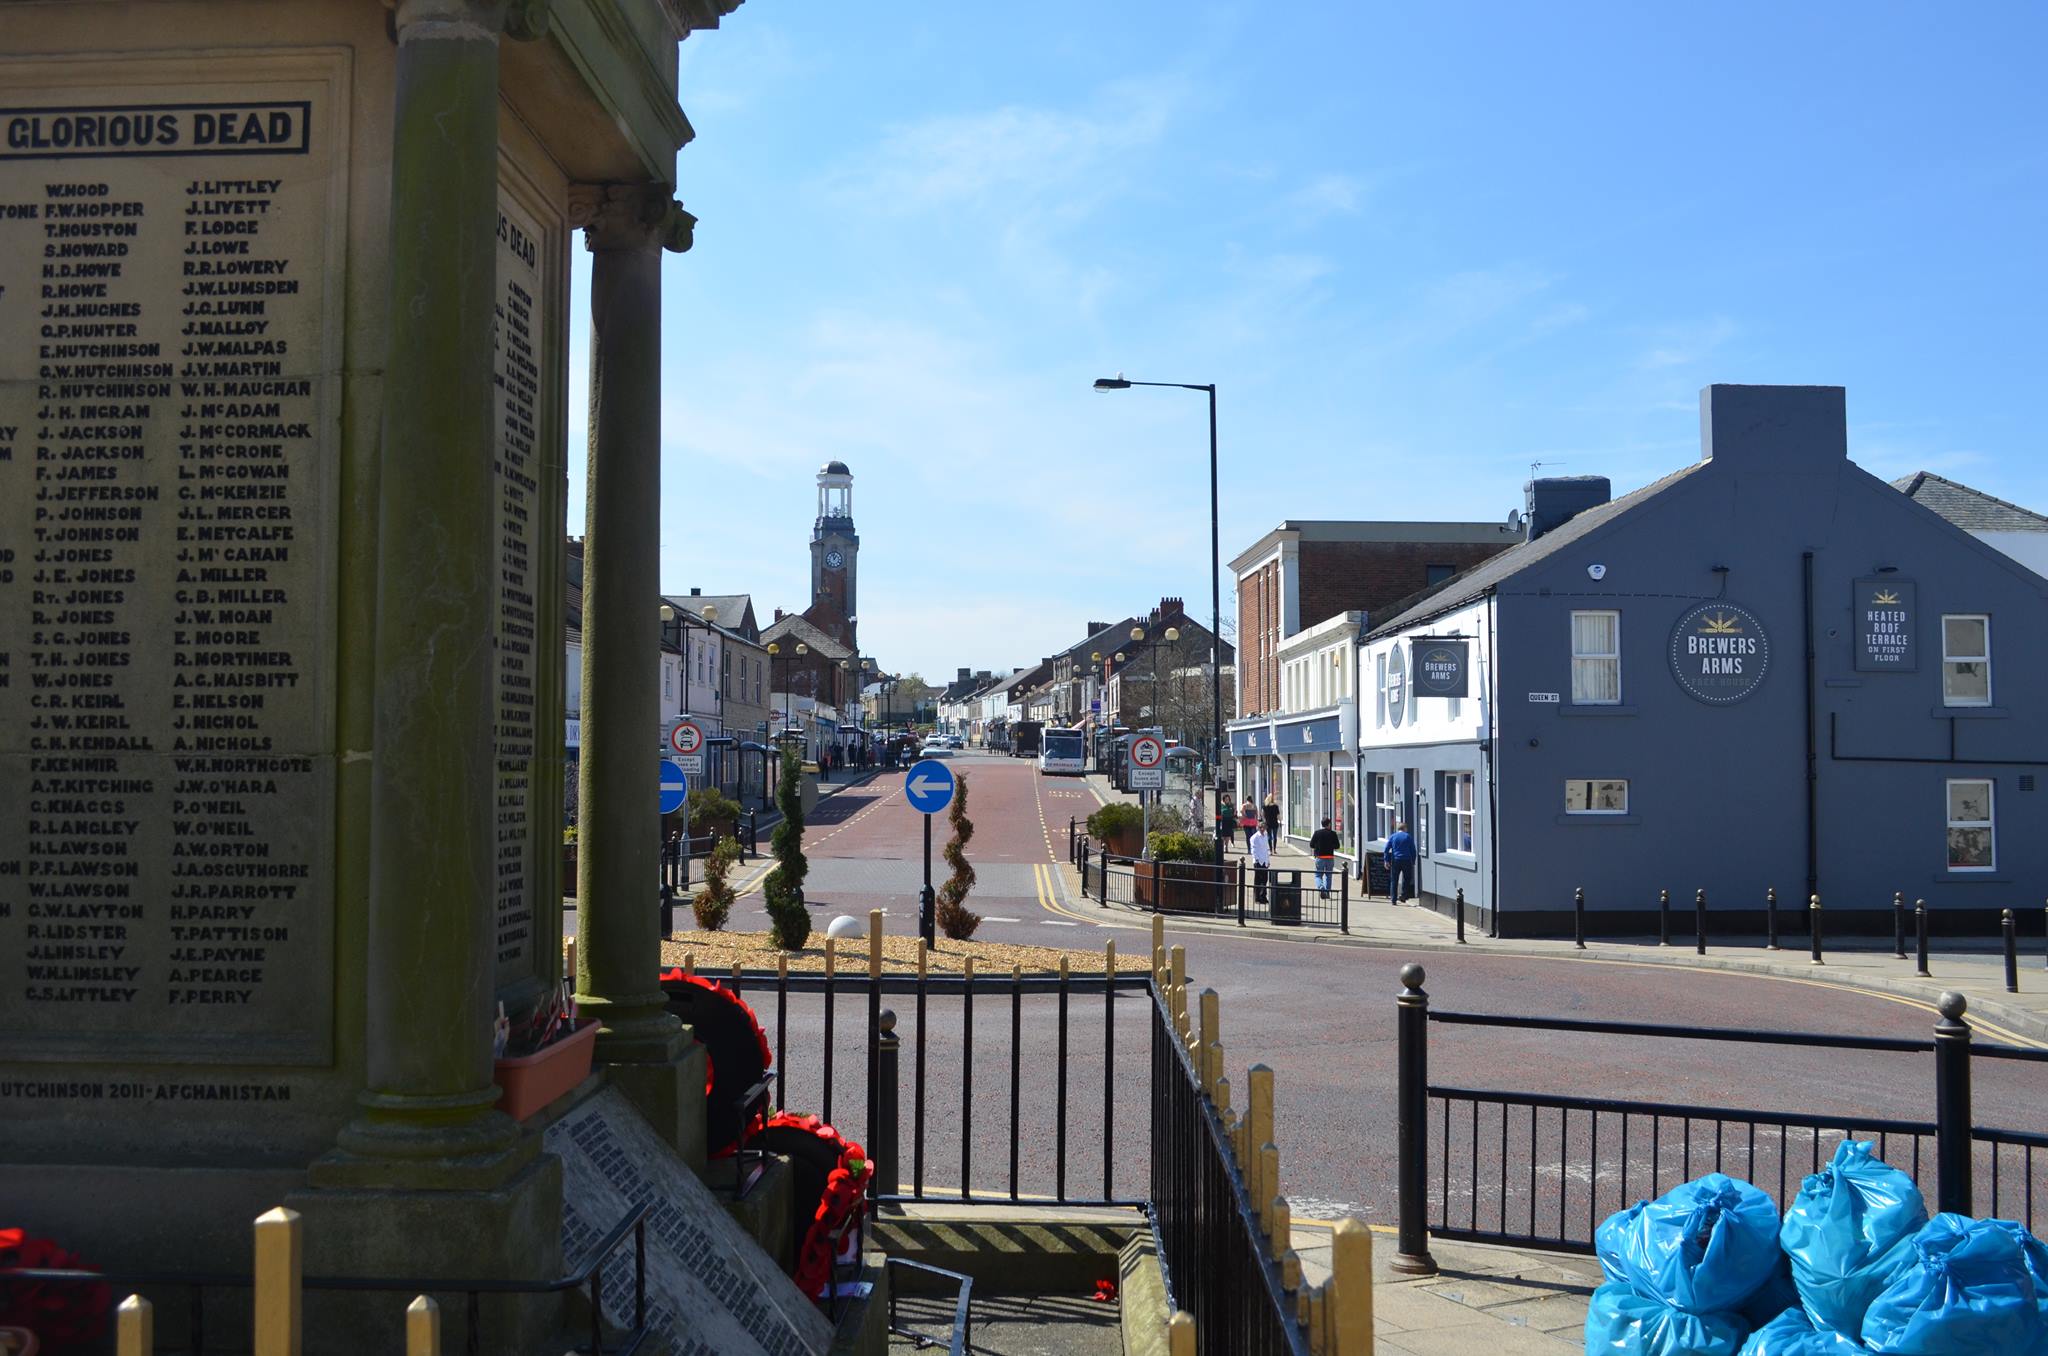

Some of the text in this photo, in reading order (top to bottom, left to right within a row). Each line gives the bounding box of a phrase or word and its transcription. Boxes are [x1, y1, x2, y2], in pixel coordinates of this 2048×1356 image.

[7, 111, 292, 148] GLORIOUS DEAD
[44, 183, 109, 198] W.HOOD
[185, 179, 283, 196] J.LITTLEY
[44, 201, 145, 219] F.W.HOPPER
[43, 222, 138, 238] T.HOUSTON
[43, 242, 129, 258] S.HOWARD
[183, 240, 250, 256] J.LOWE
[511, 223, 535, 269] DEAD
[41, 262, 122, 279] H.D.HOWE
[183, 259, 289, 277] R.R.LOWERY
[41, 283, 107, 299] R.HOWE
[181, 279, 299, 297] J.W.LUMSDEN
[40, 302, 142, 319] J.H.HUGHES
[181, 320, 270, 337] J.MALLOY
[39, 342, 161, 360] E.HUTCHINSON
[181, 339, 288, 357] J.W.MALPAS
[180, 360, 282, 378] J.V.MARTIN
[35, 485, 160, 502] J.JEFFERSON
[1867, 610, 1905, 622] HEATED
[1874, 622, 1900, 633] ROOF
[1687, 635, 1756, 654] BREWERS
[1866, 634, 1908, 645] TERRACE
[1874, 654, 1900, 662] FLOOR
[1882, 646, 1906, 654] FIRST
[173, 651, 294, 667] R.MORTIMER
[1425, 662, 1457, 672] BREWERS
[1702, 658, 1742, 674] ARMS
[31, 672, 114, 689] W.JONES
[1432, 672, 1450, 680] ARMS
[172, 714, 259, 731] J.NICHOL
[172, 735, 273, 753] A.NICHOLS
[30, 778, 154, 795] A.T.KITCHING
[172, 779, 278, 795] J.W.O'HARA
[172, 799, 247, 816] P.O'NEIL
[28, 819, 140, 836] R.LANGLEY
[172, 820, 255, 837] W.O'NEIL
[28, 840, 128, 856] H.LAWSON
[172, 841, 270, 858] A.W.ORTON
[27, 860, 139, 878] P.F.LAWSON
[27, 882, 130, 899] W.LAWSON
[170, 883, 297, 900] J.R.PARROTT
[169, 904, 257, 921] H.PARRY
[27, 923, 128, 941] R.LIDSTER
[170, 925, 289, 942] T.PATTISON
[25, 944, 126, 961] J.LINSLEY
[169, 947, 267, 963] J.E.PAYNE
[25, 964, 141, 982] W.H.LINSLEY
[167, 967, 263, 984] A.PEARCE
[168, 988, 253, 1005] F.PERRY
